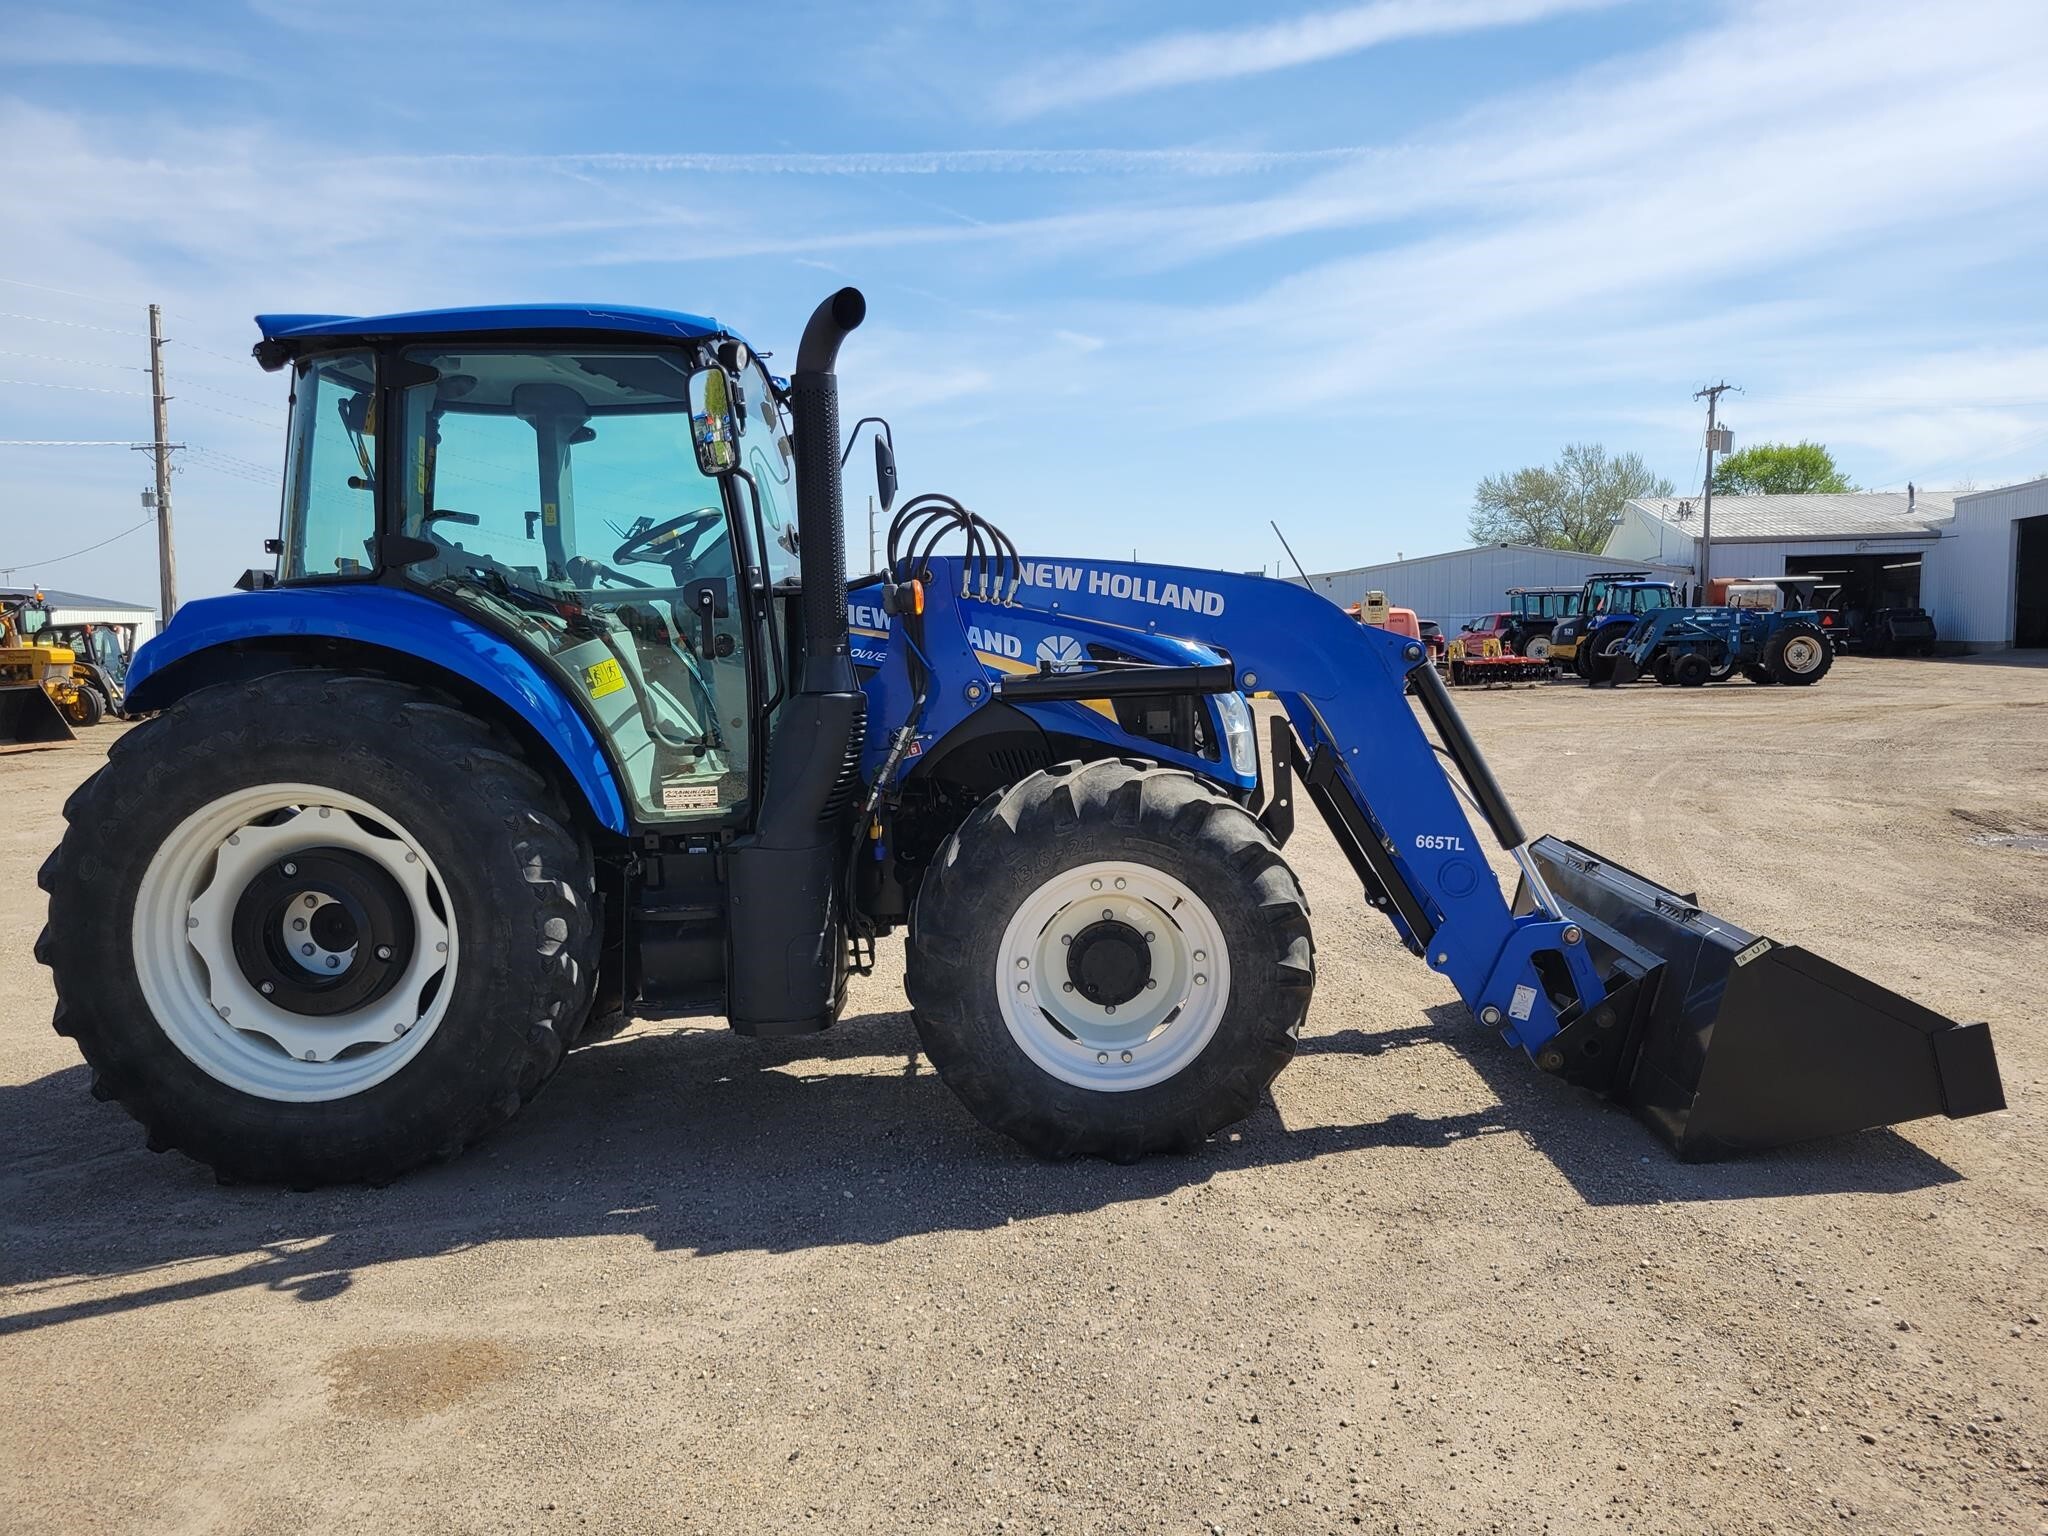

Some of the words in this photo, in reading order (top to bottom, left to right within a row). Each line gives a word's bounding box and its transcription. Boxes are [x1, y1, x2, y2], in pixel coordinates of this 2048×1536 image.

[1018, 561, 1083, 592] NEW
[1088, 570, 1225, 617] HOLLAND
[1415, 834, 1465, 851] 665TL
